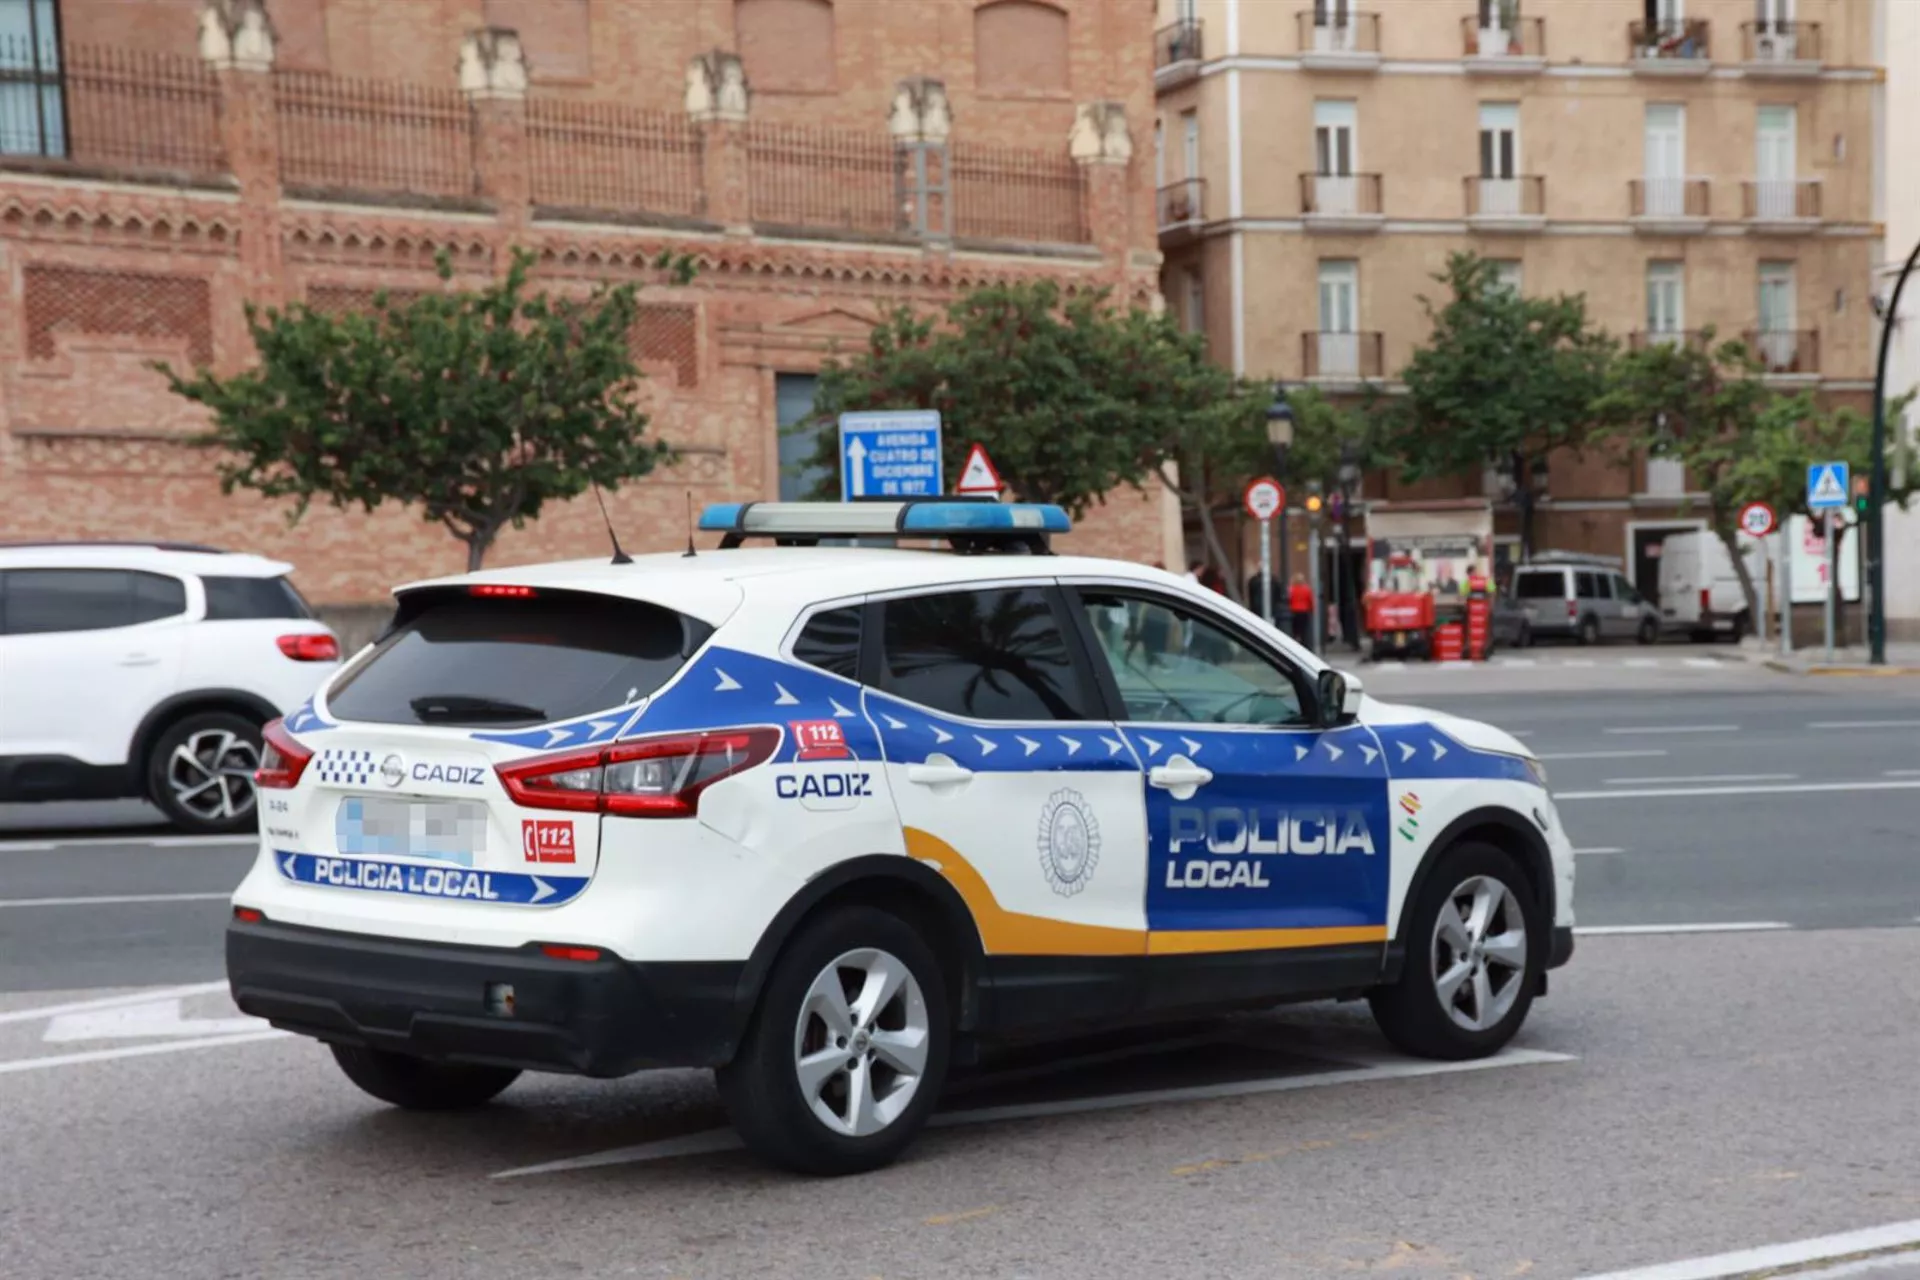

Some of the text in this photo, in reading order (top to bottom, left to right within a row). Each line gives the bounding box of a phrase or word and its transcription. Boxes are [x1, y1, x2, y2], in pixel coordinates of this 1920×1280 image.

[877, 432, 928, 446] AVENIDA
[869, 448, 918, 462] CUATRO
[873, 464, 933, 478] DICIEMBRE
[808, 724, 840, 741] 112
[412, 763, 485, 785] CADIZ
[776, 772, 872, 799] CADIZ
[538, 827, 571, 846] 112
[1168, 805, 1375, 855] POLICIA
[314, 859, 499, 901] POLICIA LOCAL
[1165, 860, 1270, 888] LOCAL
